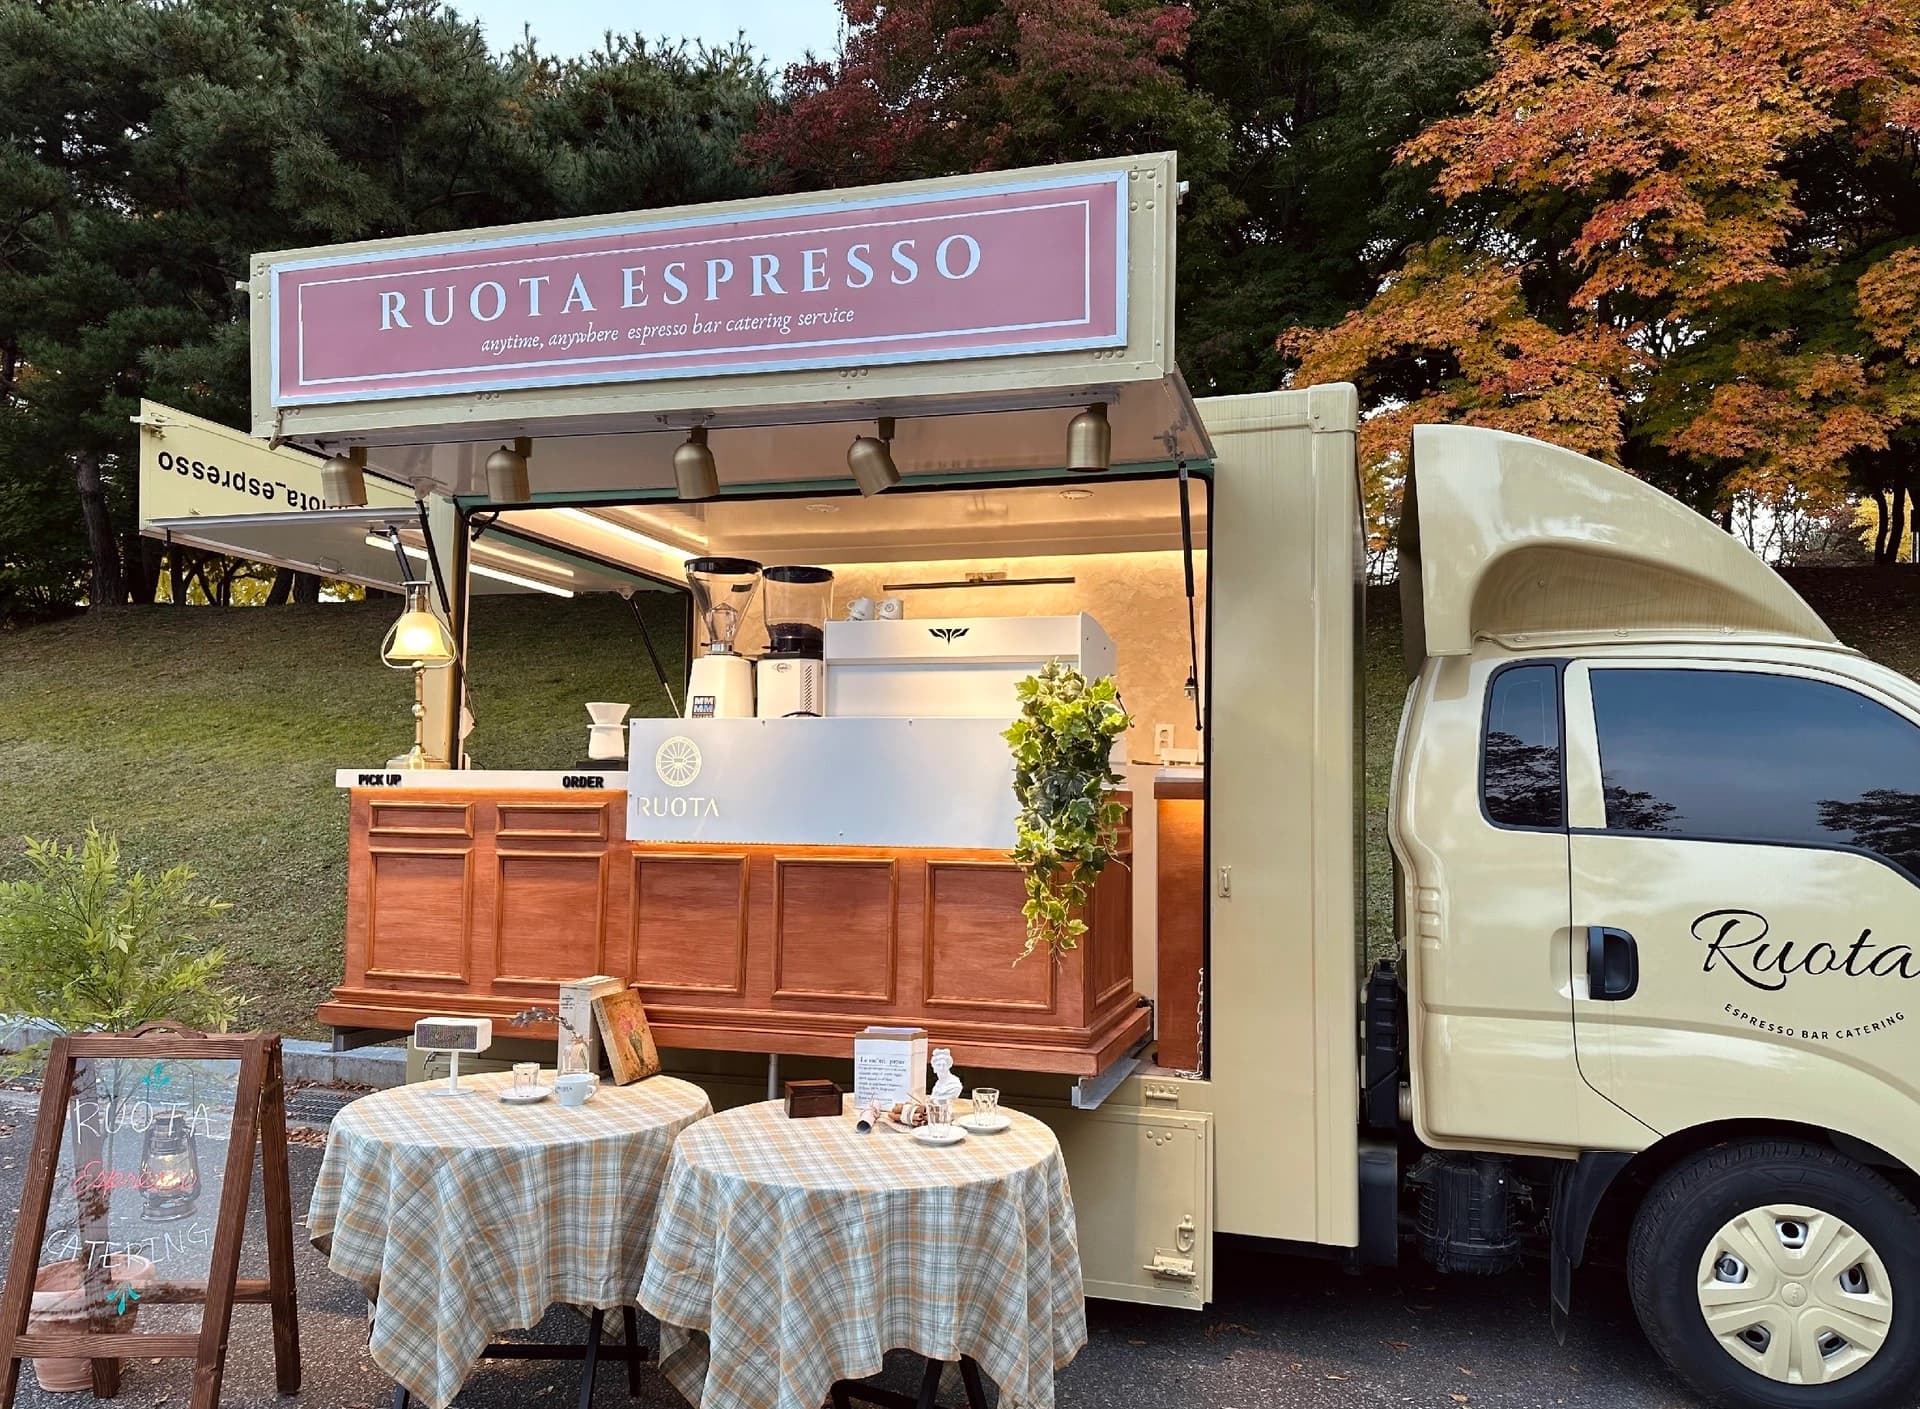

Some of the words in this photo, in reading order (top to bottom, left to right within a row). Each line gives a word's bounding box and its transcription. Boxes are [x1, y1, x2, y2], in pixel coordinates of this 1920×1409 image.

[379, 273, 596, 331] RUOTA
[621, 234, 982, 308] ESPRESSO
[480, 333, 545, 356] anytime,
[548, 322, 619, 350] anywhere
[627, 323, 688, 346] espresso
[692, 313, 722, 335] bar
[725, 312, 791, 334] catering
[797, 307, 855, 327] service
[358, 774, 384, 786] PICK
[386, 774, 401, 786] UP
[562, 775, 604, 788] ORDER
[636, 796, 719, 817] RUOTA
[1691, 908, 1920, 991] Ruota
[1724, 1003, 1795, 1037] ESPRESSO
[1801, 1029, 1829, 1040] BAR
[1835, 1010, 1905, 1040] CATERING
[74, 1099, 216, 1144] RUOTA
[46, 1222, 209, 1270] CATERING
